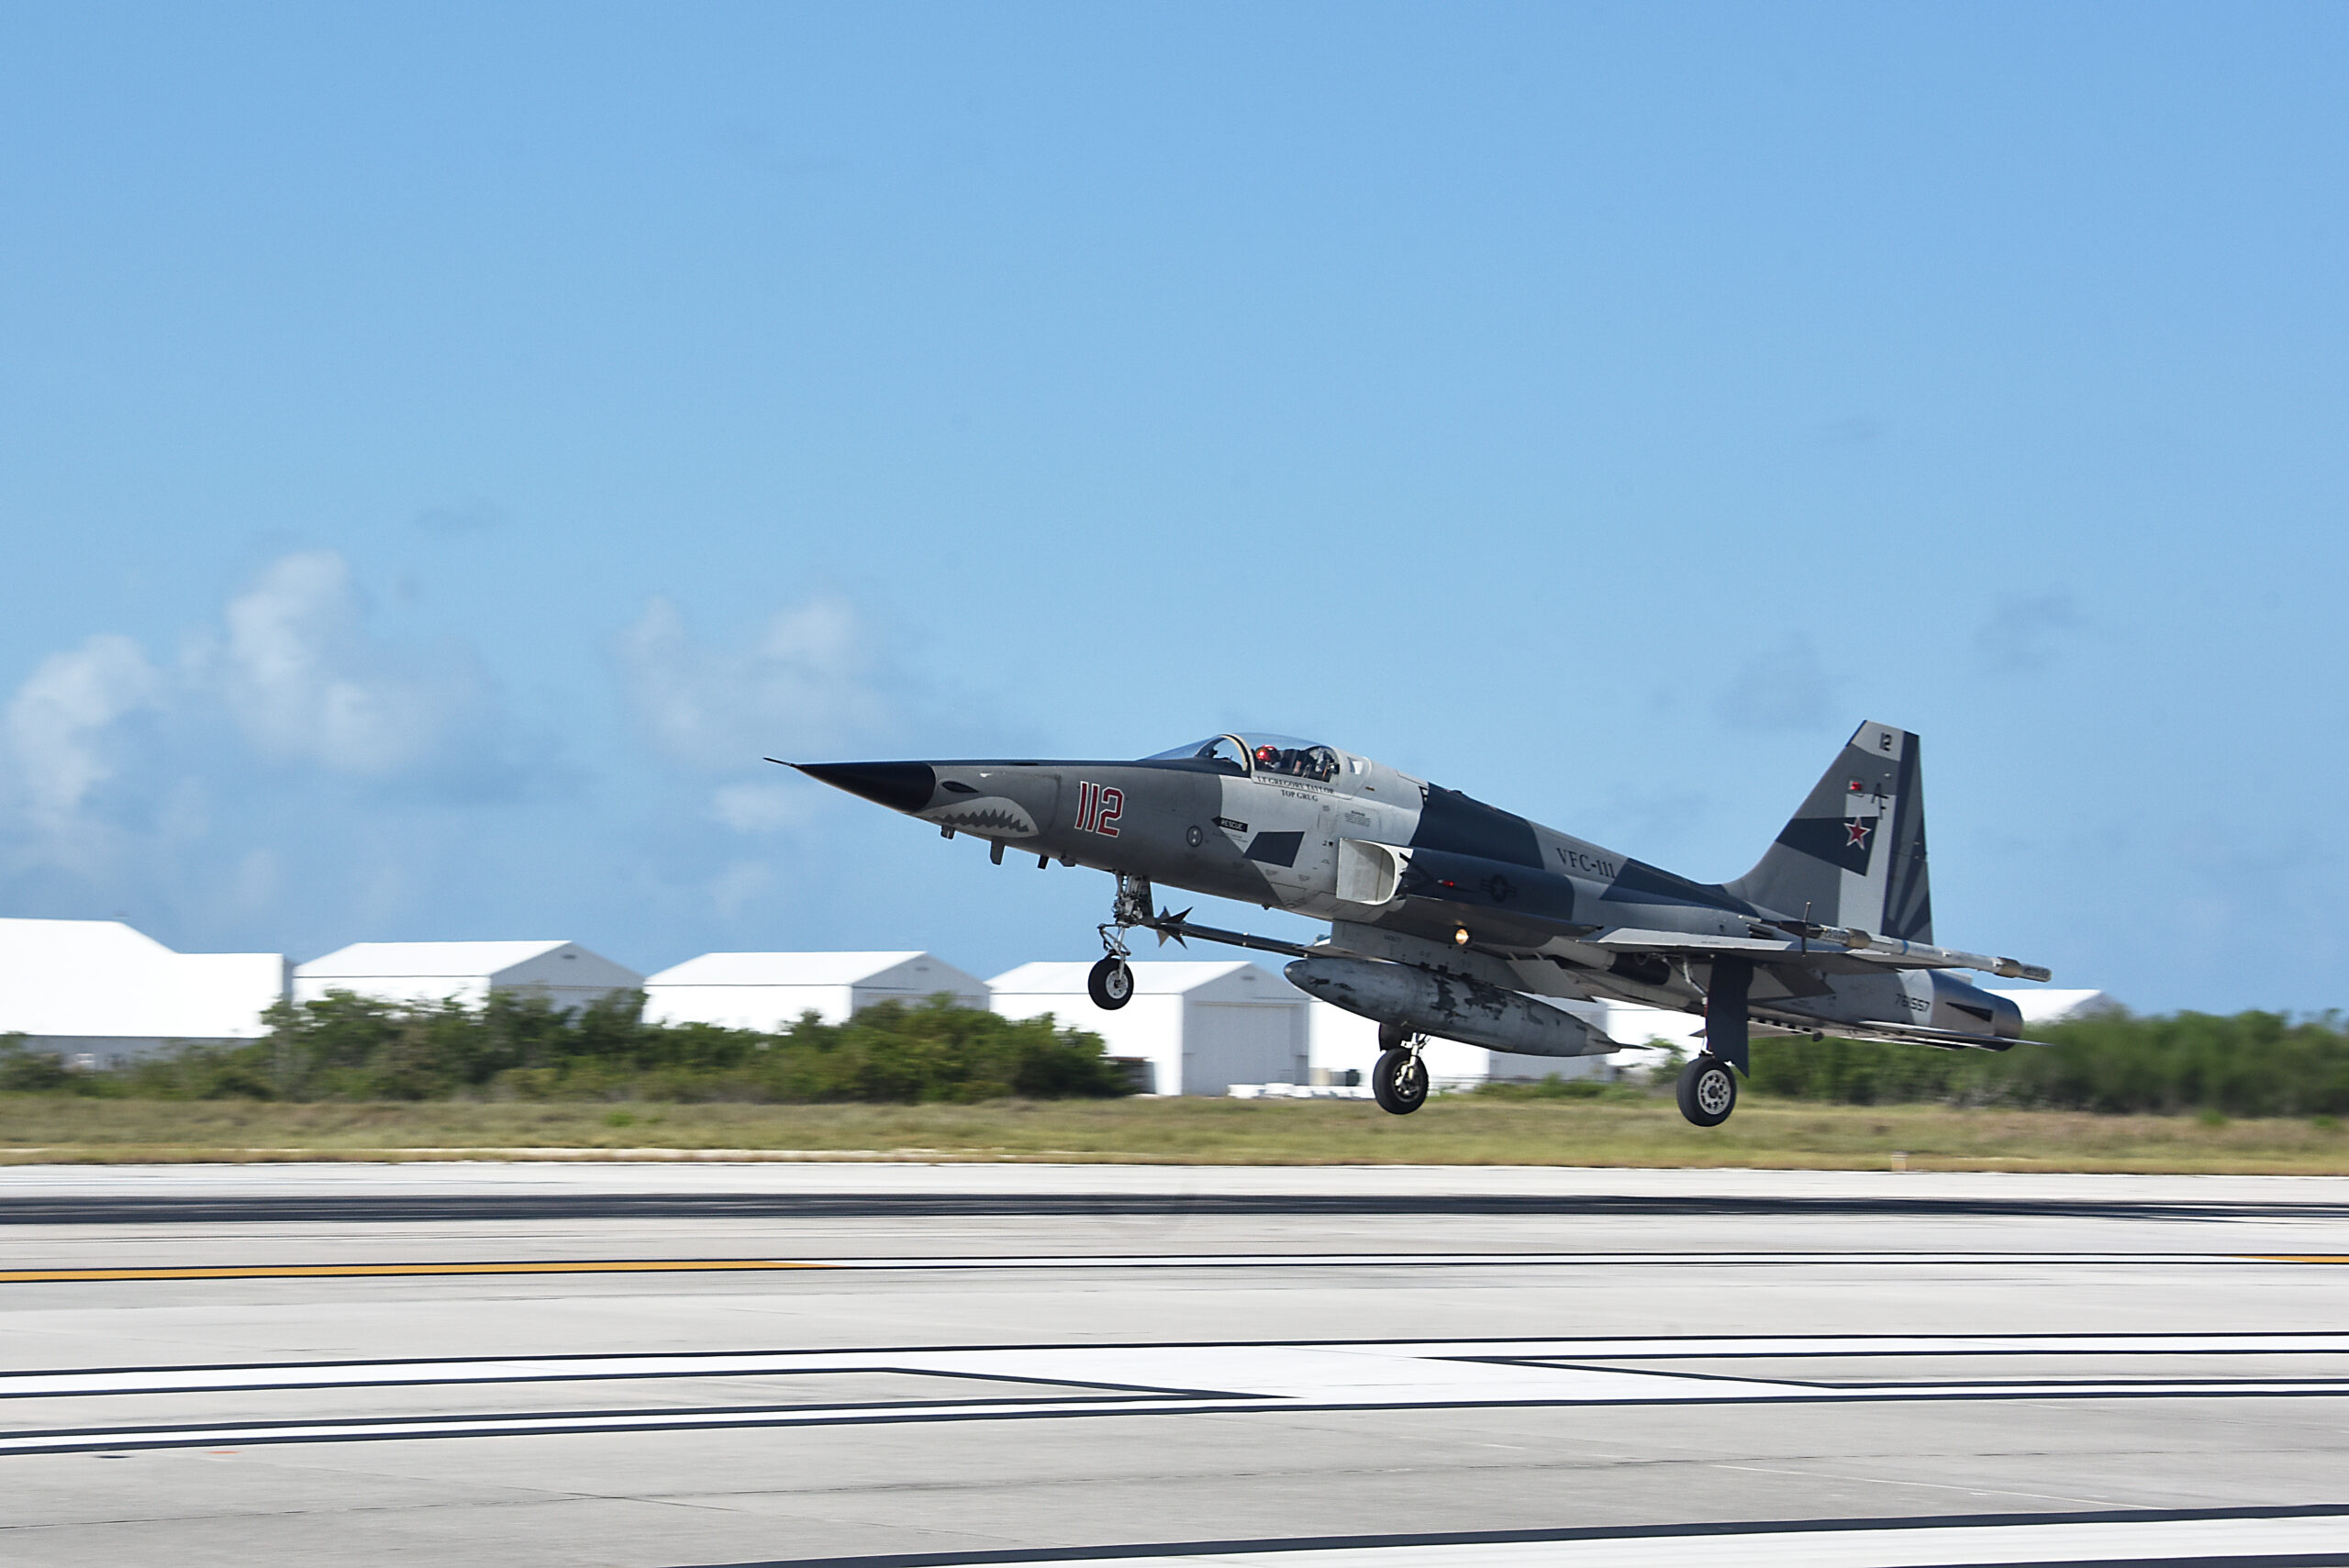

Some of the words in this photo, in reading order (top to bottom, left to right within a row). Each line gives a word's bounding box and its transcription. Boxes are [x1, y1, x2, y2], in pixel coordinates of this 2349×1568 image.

[1878, 732, 1892, 751] 12
[1281, 789, 1296, 798] TOP
[1305, 784, 1335, 794] TAYLOR
[1074, 780, 1124, 838] 112
[1220, 818, 1244, 830] RESCUE
[1556, 847, 1616, 878] VFC-111
